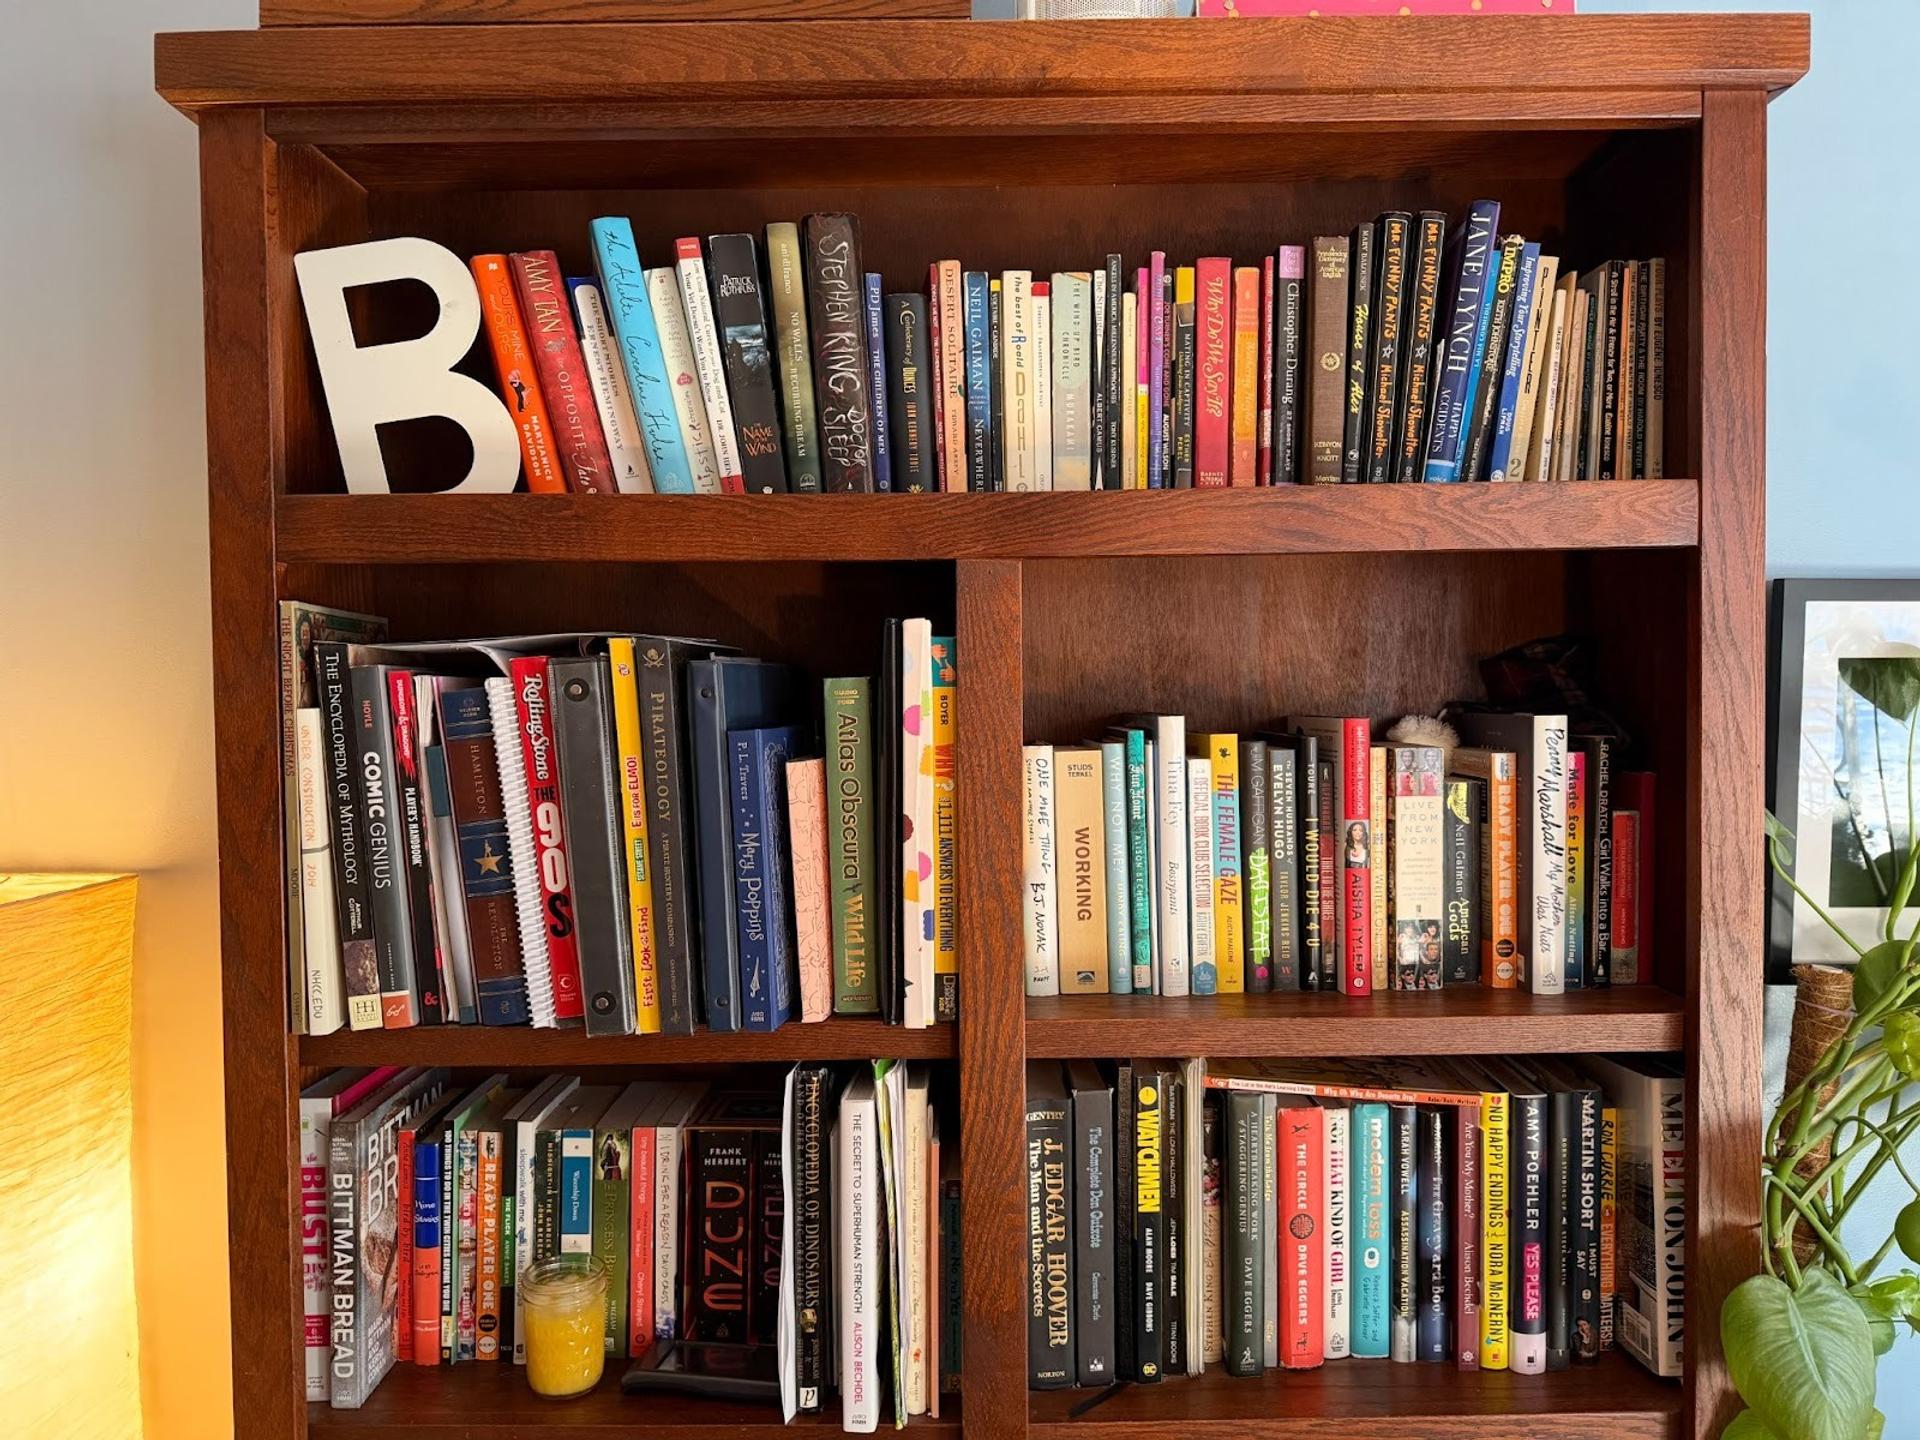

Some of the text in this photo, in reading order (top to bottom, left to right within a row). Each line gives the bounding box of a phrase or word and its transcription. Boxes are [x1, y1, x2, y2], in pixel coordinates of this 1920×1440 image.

[523, 256, 563, 334] AMY TAN
[1422, 248, 1437, 292] FUNNY
[1447, 212, 1492, 374] JANE LYNCH
[1498, 246, 1516, 294] IMPRO
[1517, 256, 1536, 302] Improving
[589, 293, 620, 397] THE SHORT STORIES
[603, 230, 671, 466] the Adults Caroline Hulse
[818, 236, 861, 395] STEPHEN KING
[870, 287, 881, 338] PD James
[945, 268, 957, 399] DESERT SOLITAIRE
[1011, 336, 1027, 368] Roald
[1015, 322, 1023, 334] of
[1202, 277, 1224, 418] Why Do We Say It?
[1284, 282, 1299, 354] Christopher
[1417, 296, 1432, 340] PANTS
[1506, 324, 1525, 378] Storytelling
[1515, 304, 1529, 326] Your
[295, 237, 521, 496] B
[586, 324, 623, 451] ERNEST HEMINGWAY
[970, 287, 985, 492] NEIL GAIMAN NEVERWHERE
[1282, 358, 1295, 404] Durang
[1350, 304, 1368, 414] House of Alex
[1410, 364, 1426, 403] Michael
[557, 371, 587, 451] OPPOSITE
[823, 407, 851, 467] SLEEP
[847, 406, 869, 466] DOCTOR
[873, 350, 885, 455] THE CHILDREN OF MEN
[1404, 406, 1421, 458] Showalter
[1432, 386, 1451, 453] ACCIDENTS
[1448, 402, 1461, 441] HAPPY
[522, 415, 553, 481] MARYJANICE DAVIDSON
[362, 699, 374, 728] HOYLE
[938, 694, 950, 726] BOYER
[300, 725, 317, 842] UNDER CONSTRUCTION
[325, 652, 358, 885] THE ENCYCLOPEDIA OF MYTHOLOGY
[470, 744, 487, 815] HAMILTON
[649, 691, 671, 821] PIRATEOLOGY
[1163, 757, 1183, 828] Tina Fey
[1536, 728, 1564, 856] Penny Marshall
[1600, 744, 1609, 834] RACHEL DRATCH
[363, 751, 392, 889] COMIC GENIUS
[404, 787, 423, 866] PLAYER'S HANDBOOK
[837, 712, 867, 988] Atlas Obscura Wild Life
[1110, 756, 1122, 873] WHY NOT ME?
[1218, 774, 1237, 906] THE FEMALE GAZE
[1274, 764, 1284, 859] EVELYN HUGO
[1600, 838, 1611, 860] Girl
[739, 831, 765, 942] Mary Poppins
[938, 837, 954, 952] ANSWERS TO EVERYTHING
[1075, 826, 1092, 922] WORKING
[1305, 830, 1318, 882] WOULD
[1600, 863, 1610, 896] Walks
[487, 902, 504, 971] REVOLUTION
[1036, 912, 1046, 954] NOVAK
[1306, 890, 1319, 915] DIE
[1306, 922, 1319, 932] 4
[1599, 898, 1609, 920] into
[1307, 939, 1320, 947] U
[704, 1158, 747, 1166] HERBERT
[710, 1147, 742, 1155] FRANK
[1137, 1110, 1160, 1212] WATCHMEN
[1297, 1144, 1307, 1209] THE CIRCLE
[1489, 1106, 1504, 1228] NO HAPPY ENDINGS
[1527, 1106, 1539, 1230] AMY POEHLER
[1581, 1098, 1595, 1231] MARTIN SHORT
[301, 1167, 328, 1260] BUST
[804, 1083, 820, 1308] ENCYCLOPEDIA OF DINOSAURS
[1029, 1139, 1044, 1317] The Man and the Secrets
[332, 1173, 354, 1379] BITTMAN BREAD
[483, 1163, 497, 1310] READY PLAYER ONE
[853, 1113, 863, 1405] THE SECRET TO SUPERHUMAN STRENGTH ALISON BECHDEL
[1044, 1138, 1068, 1347] J. EDGAR HOOVER
[1298, 1244, 1307, 1325] DAVE EGGERS
[1489, 1243, 1504, 1344] NORA McINERNY
[1526, 1244, 1540, 1320] YES PLEASE
